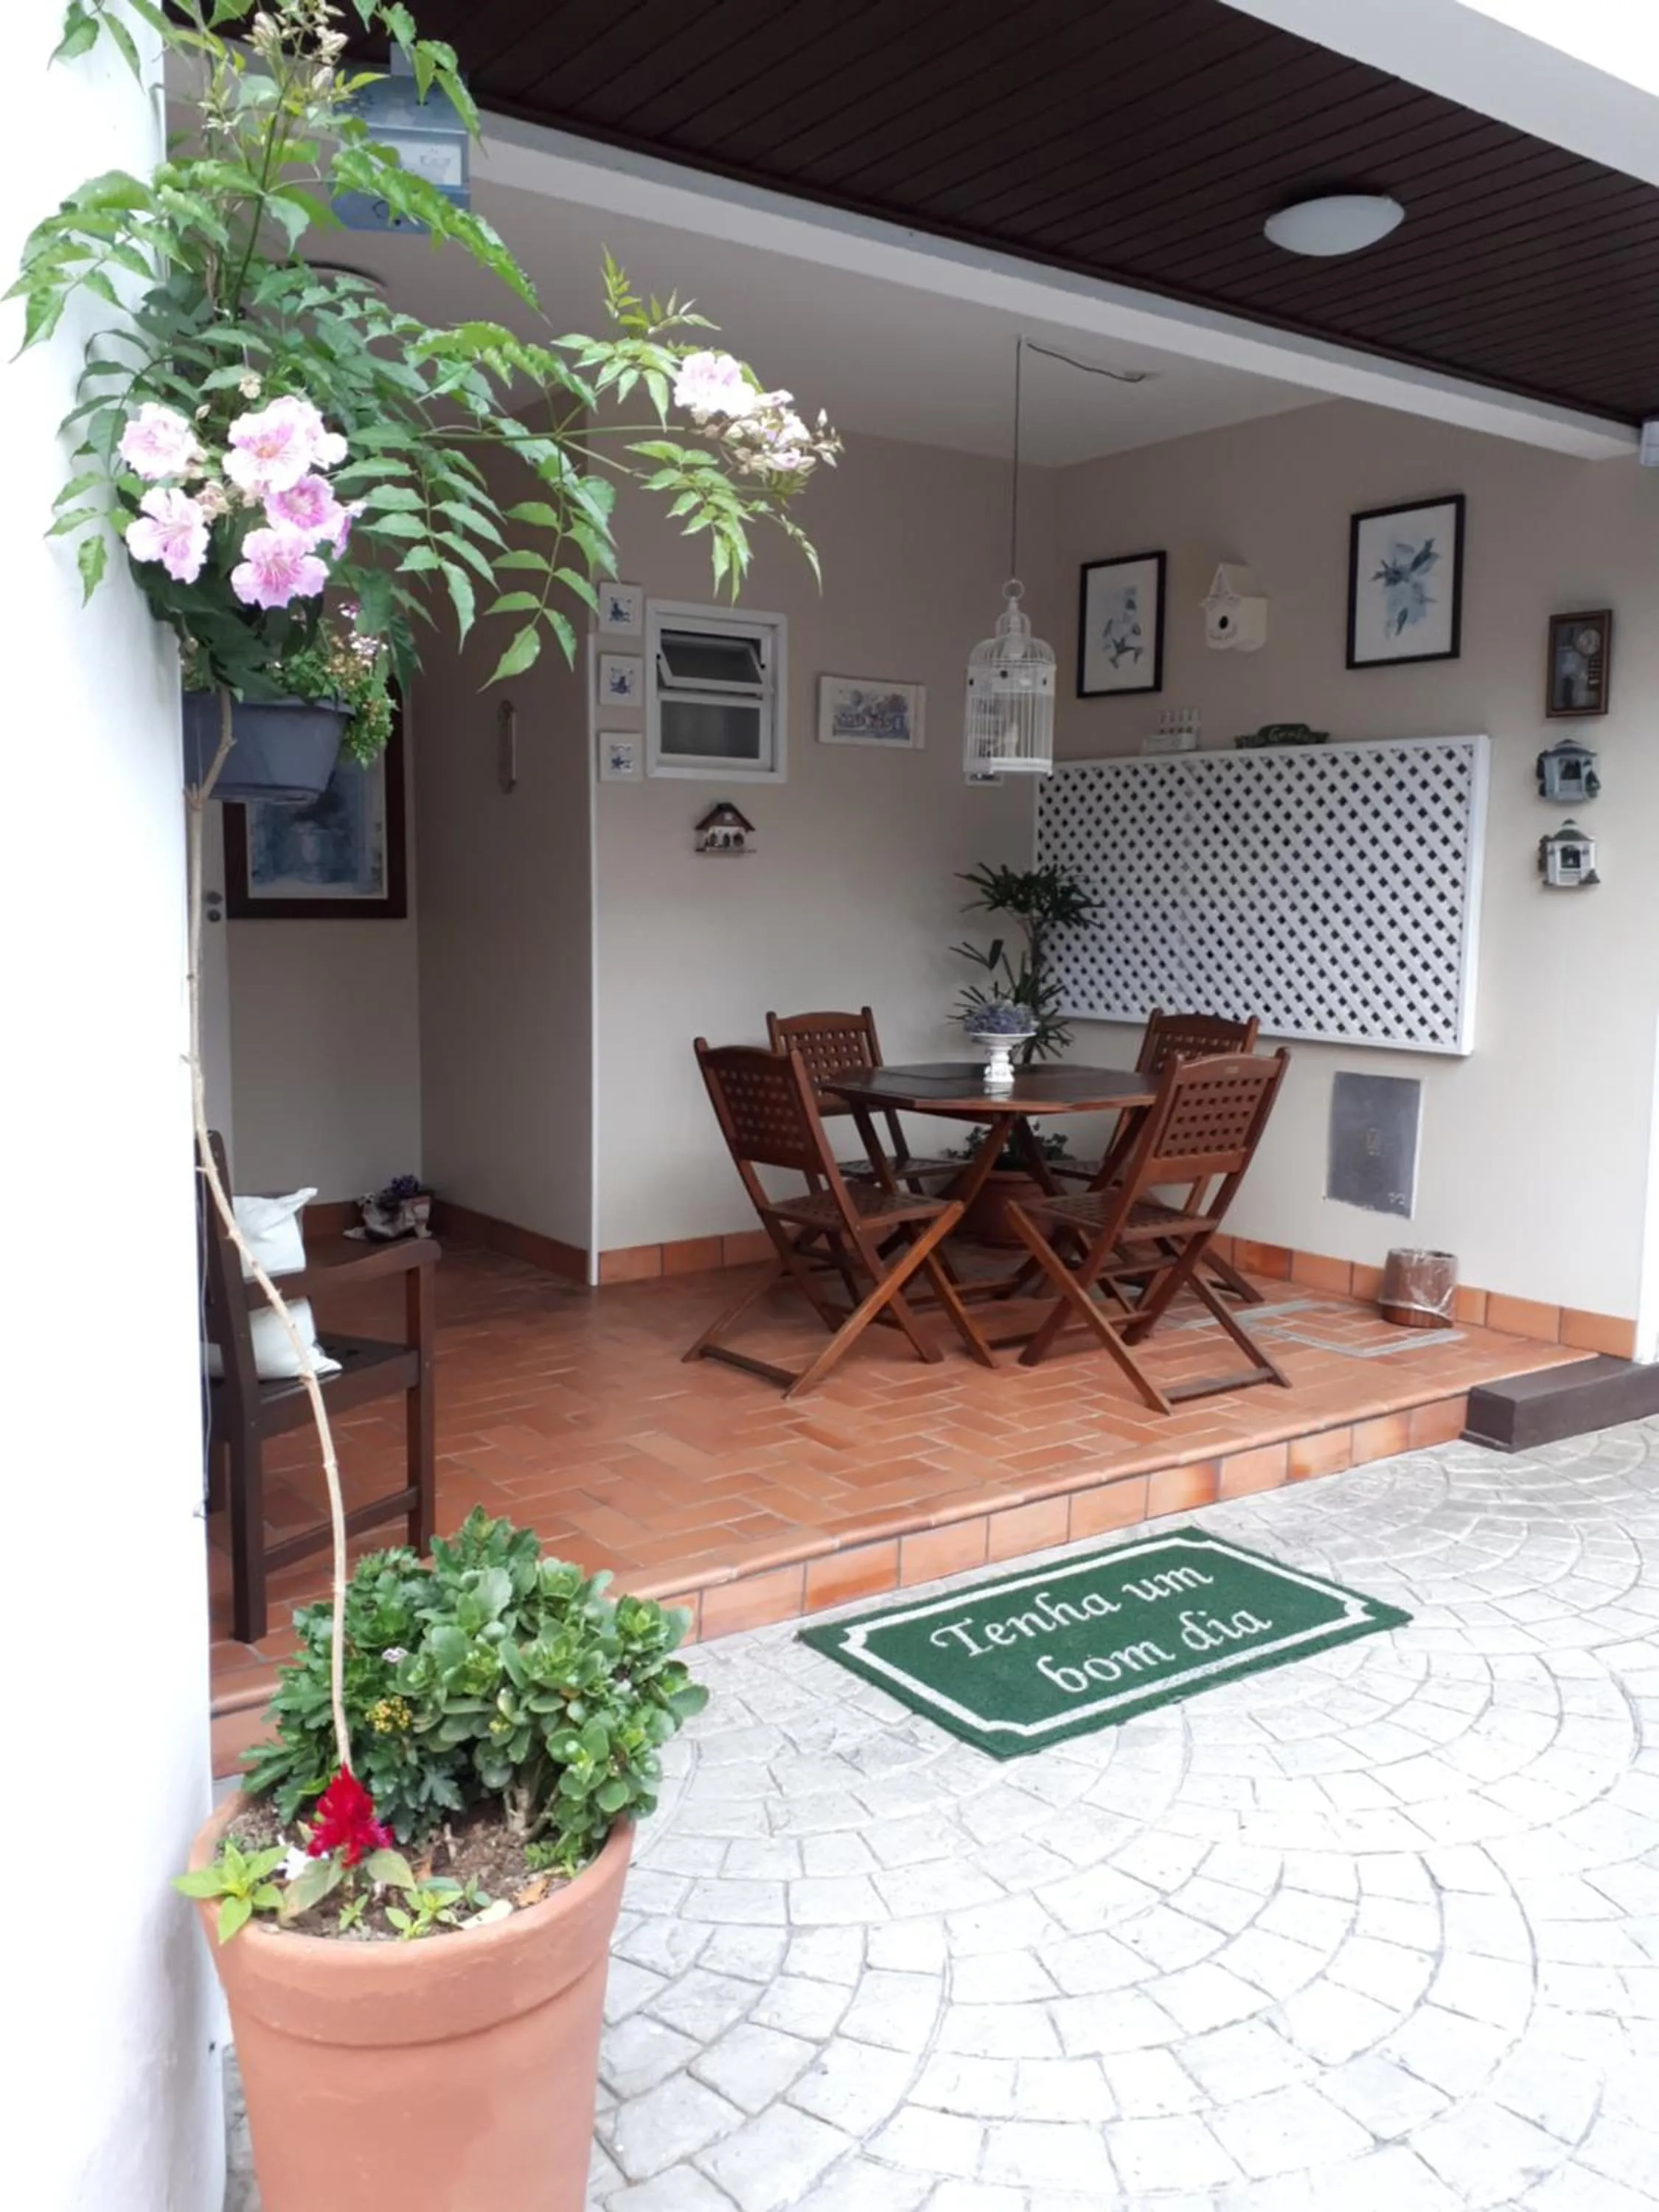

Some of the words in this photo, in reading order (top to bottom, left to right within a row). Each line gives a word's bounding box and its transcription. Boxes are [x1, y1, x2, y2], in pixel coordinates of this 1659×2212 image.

[931, 1591, 1121, 1657] Tenha
[1121, 1567, 1214, 1602] um
[1036, 1641, 1175, 1693] bom
[1179, 1610, 1273, 1652] dia
